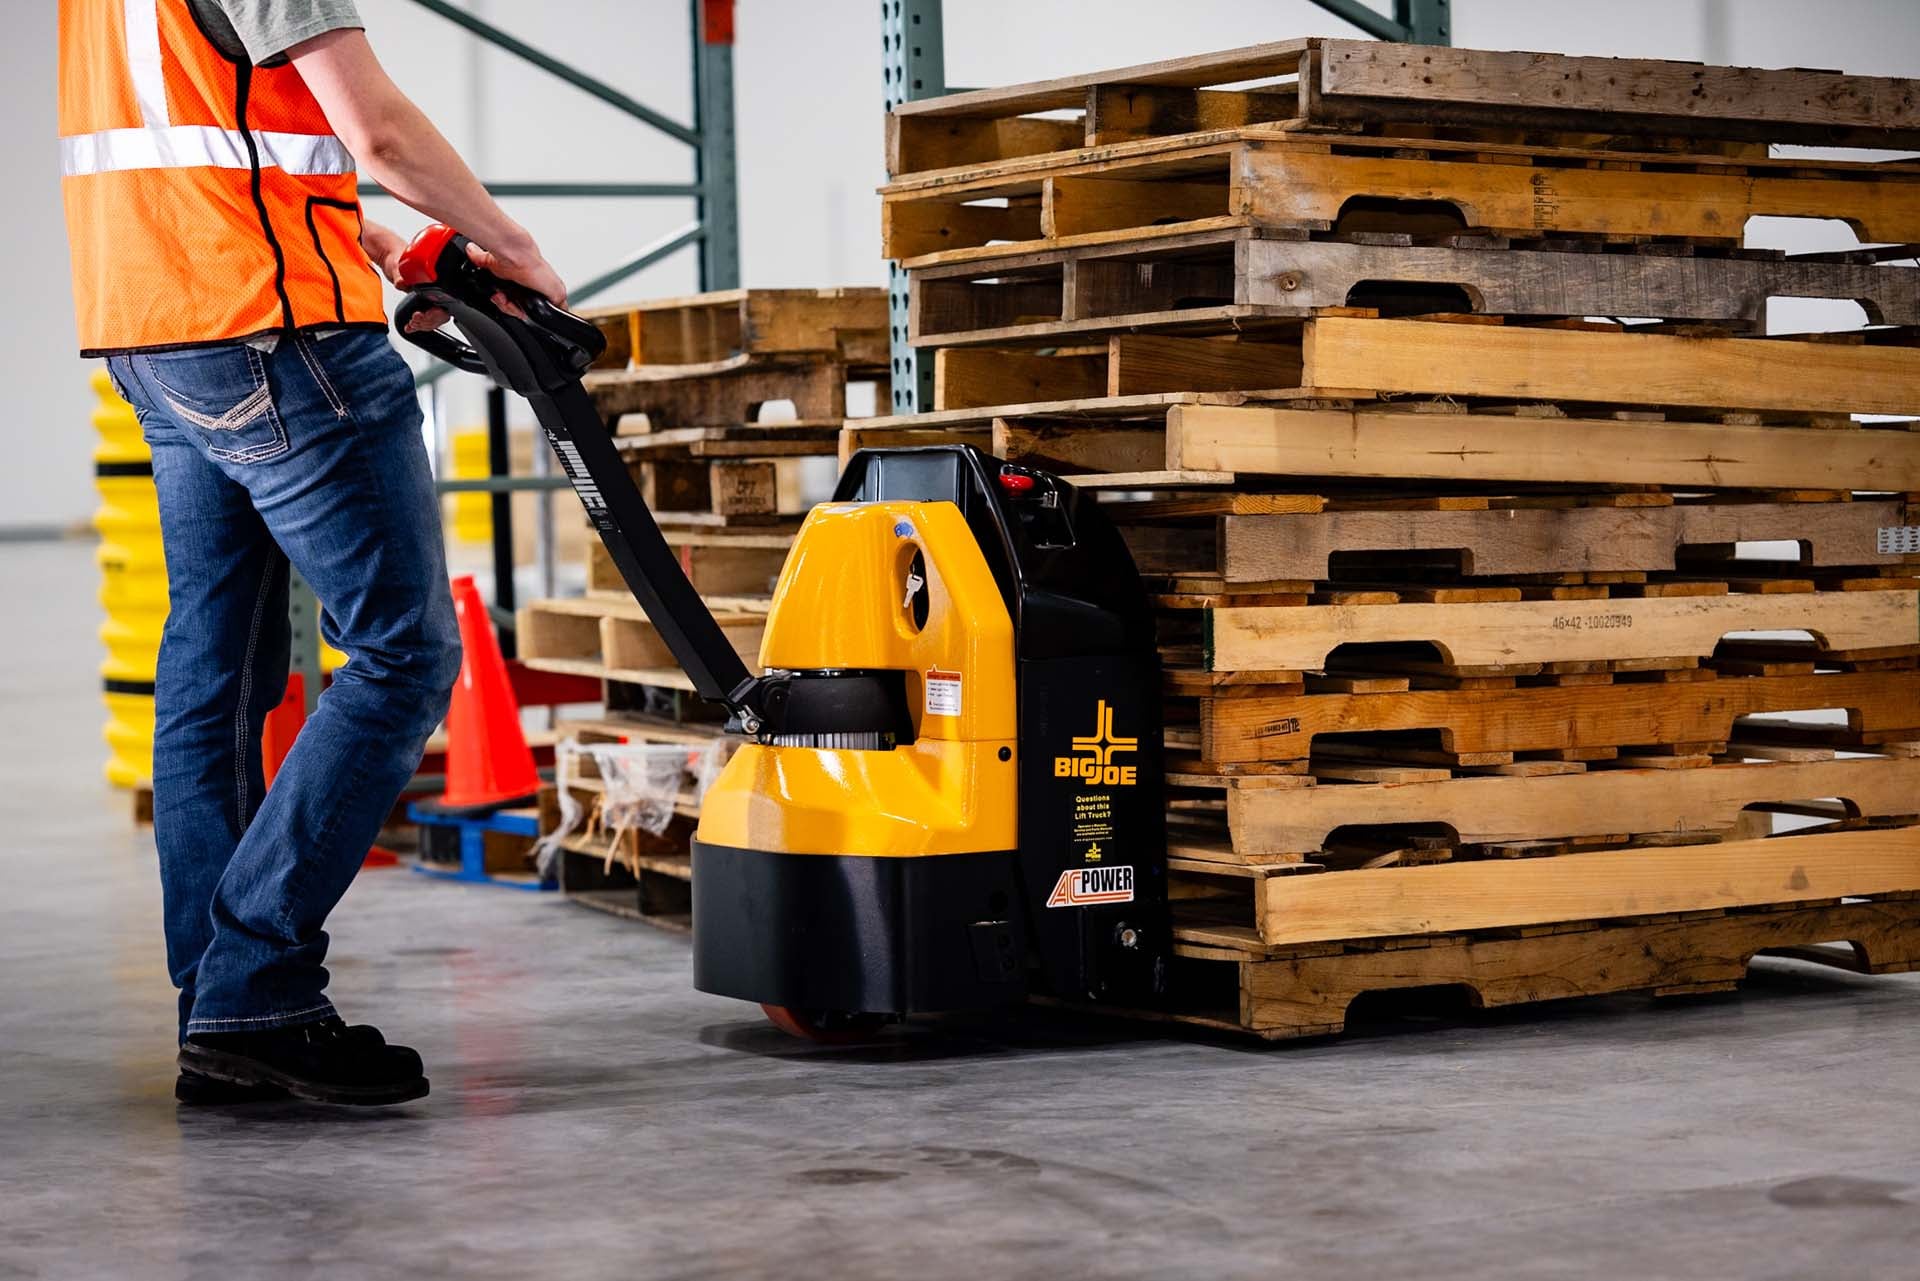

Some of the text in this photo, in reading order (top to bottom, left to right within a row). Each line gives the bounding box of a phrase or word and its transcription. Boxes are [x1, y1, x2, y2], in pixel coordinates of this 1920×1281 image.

[1055, 758, 1096, 777] BIG
[1086, 766, 1136, 785] JOE
[1075, 795, 1110, 803] Questions
[1076, 802, 1110, 812] about this
[1075, 810, 1112, 820] Lift Truck?
[1081, 867, 1132, 894] POWER
